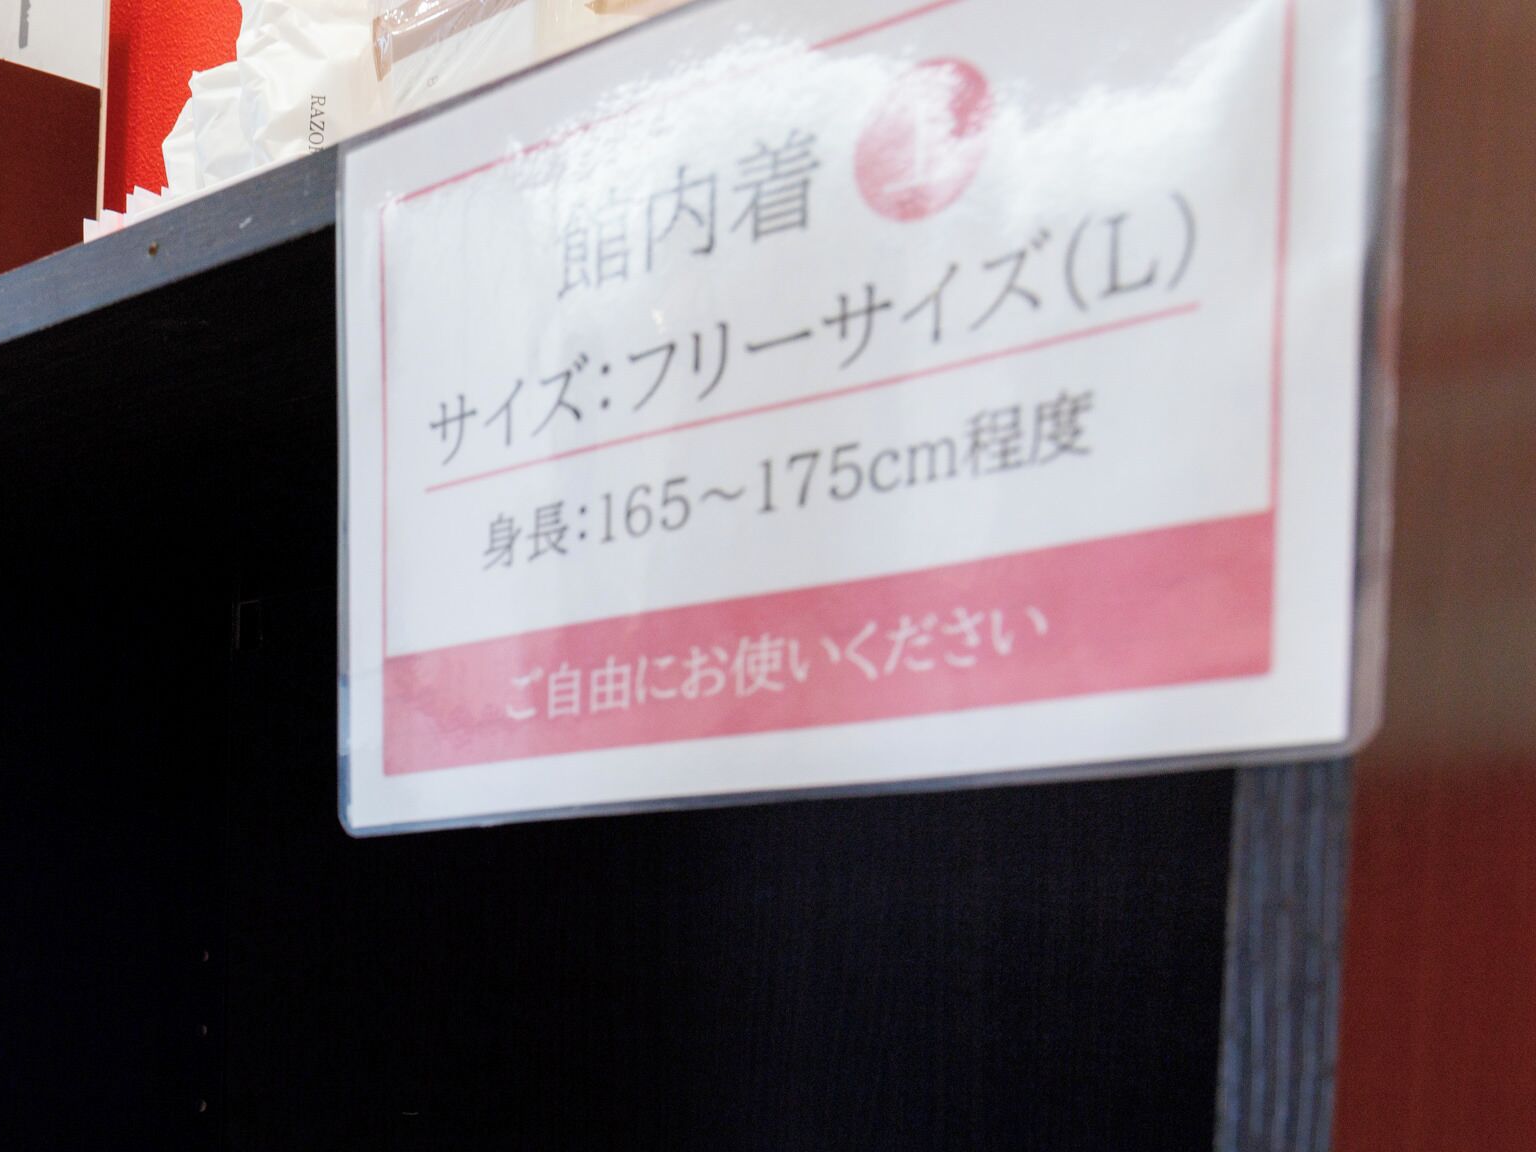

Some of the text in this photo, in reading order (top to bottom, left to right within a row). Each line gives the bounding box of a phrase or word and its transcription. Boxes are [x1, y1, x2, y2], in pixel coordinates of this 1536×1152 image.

[556, 127, 822, 301] 館内着
[428, 191, 1197, 466] サイズ:フリーサイズ(L)
[505, 603, 1050, 721] ご自由にお使いください
